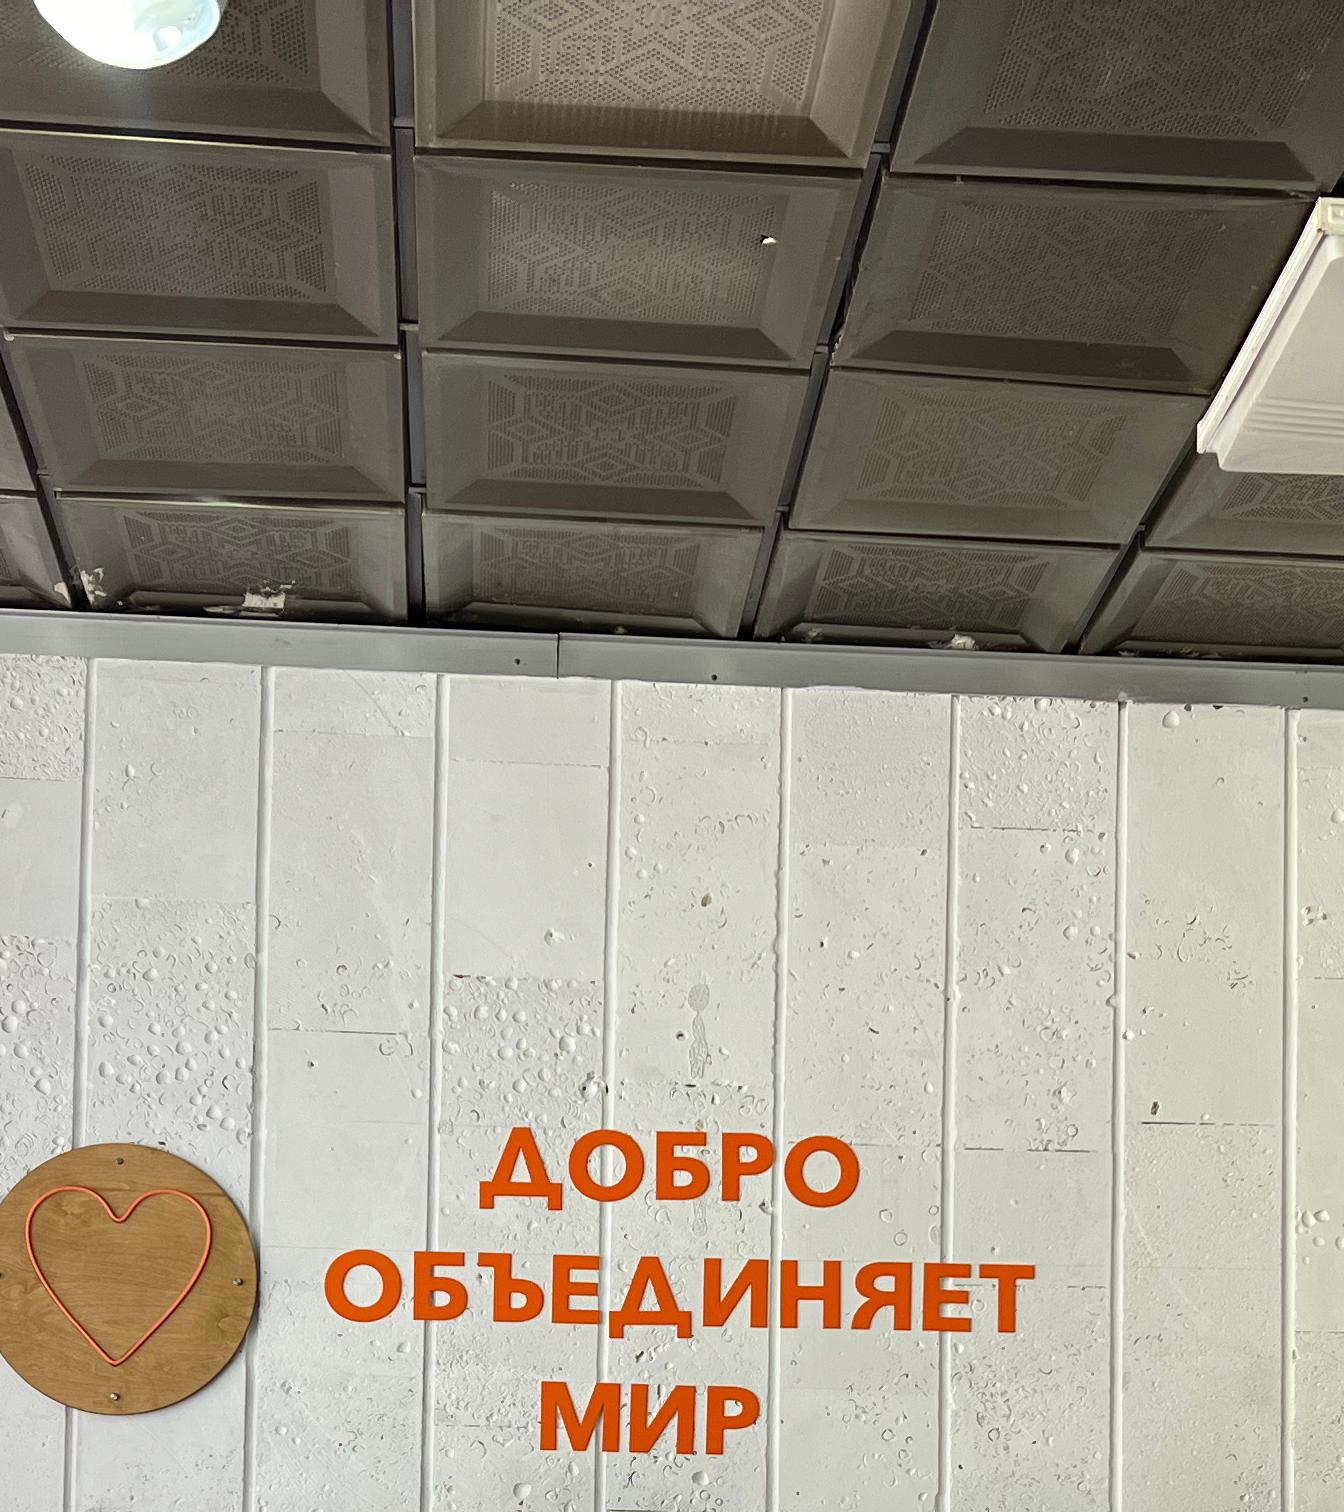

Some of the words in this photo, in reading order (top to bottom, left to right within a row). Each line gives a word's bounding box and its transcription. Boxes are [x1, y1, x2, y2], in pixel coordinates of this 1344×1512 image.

[479, 1126, 860, 1211] ДОБРО
[324, 1248, 1036, 1339] ОБЪЕДИНЯЕТ
[539, 1381, 760, 1455] МИР
